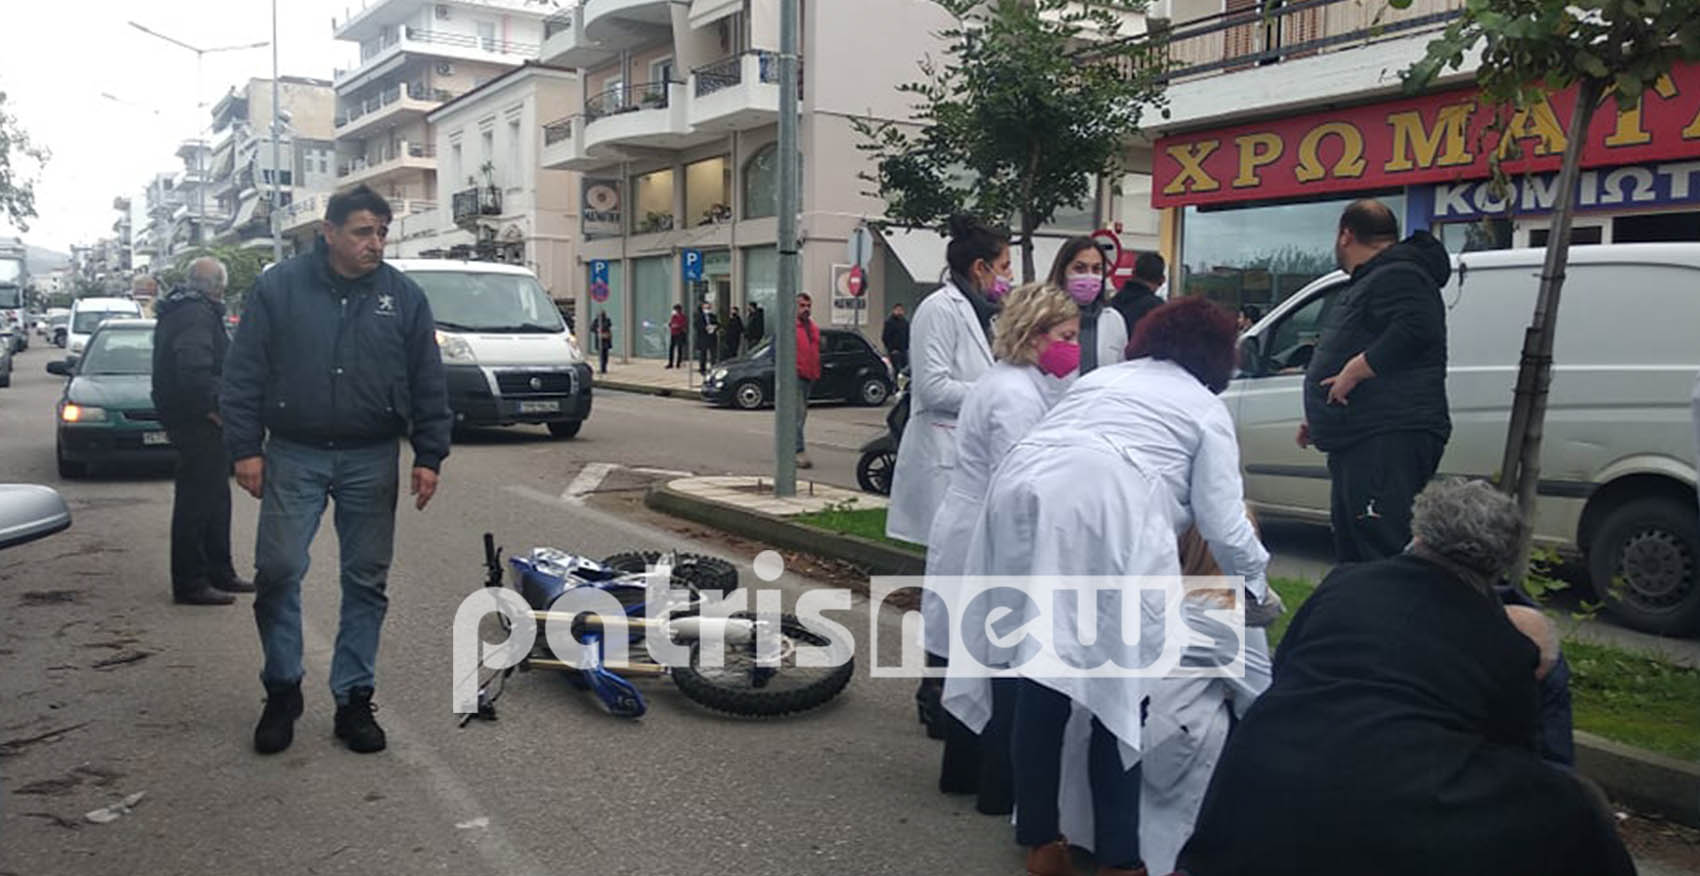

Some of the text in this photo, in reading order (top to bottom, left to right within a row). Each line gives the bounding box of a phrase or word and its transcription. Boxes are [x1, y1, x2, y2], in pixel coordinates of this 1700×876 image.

[1163, 70, 1700, 195] ΧΡΩΜΑΤ
[685, 252, 698, 267] P
[594, 262, 606, 274] P
